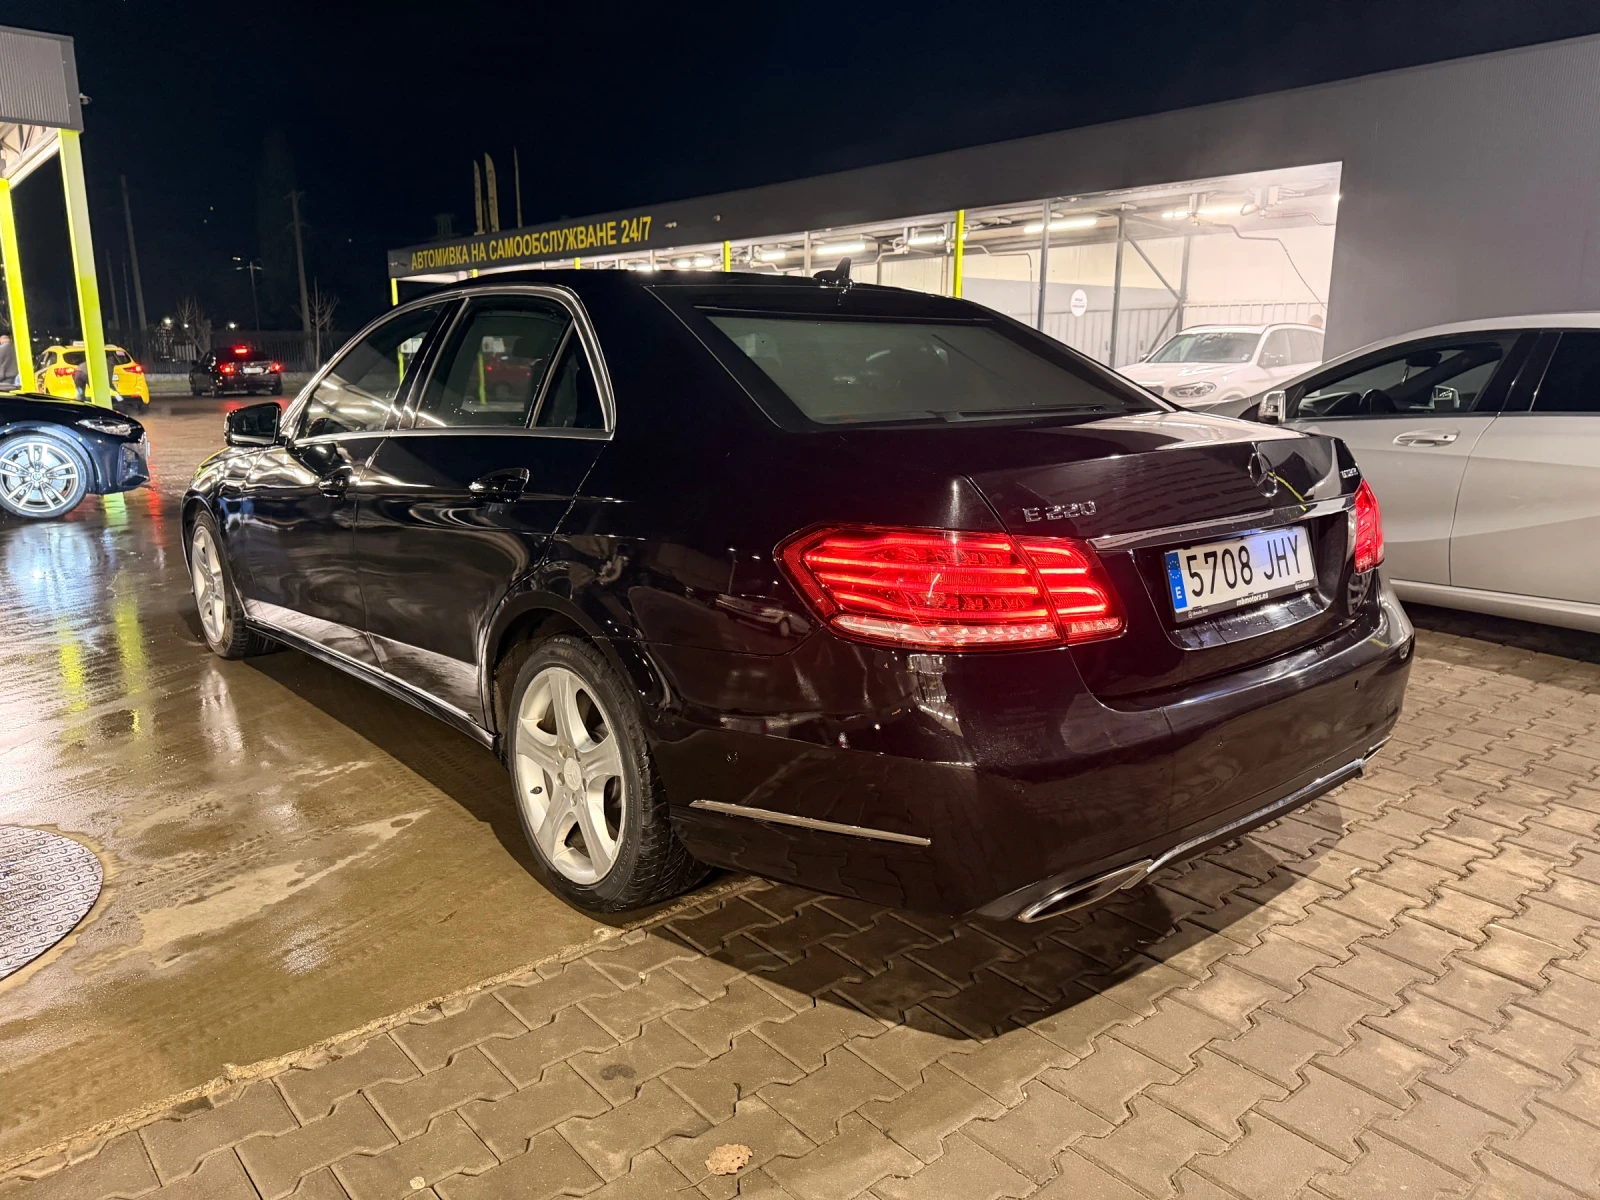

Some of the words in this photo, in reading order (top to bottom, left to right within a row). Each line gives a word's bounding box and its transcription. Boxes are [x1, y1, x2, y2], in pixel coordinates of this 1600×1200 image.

[411, 244, 469, 271] АВТОМИВКА
[471, 241, 487, 262] НА
[489, 221, 617, 260] САМООБСЛУЖВАНЕ
[621, 216, 652, 244] 24/7
[1022, 507, 1042, 522] E
[1045, 500, 1097, 520] 220
[1186, 545, 1253, 597] 5708
[1264, 535, 1301, 580] JHY
[1175, 586, 1183, 600] E
